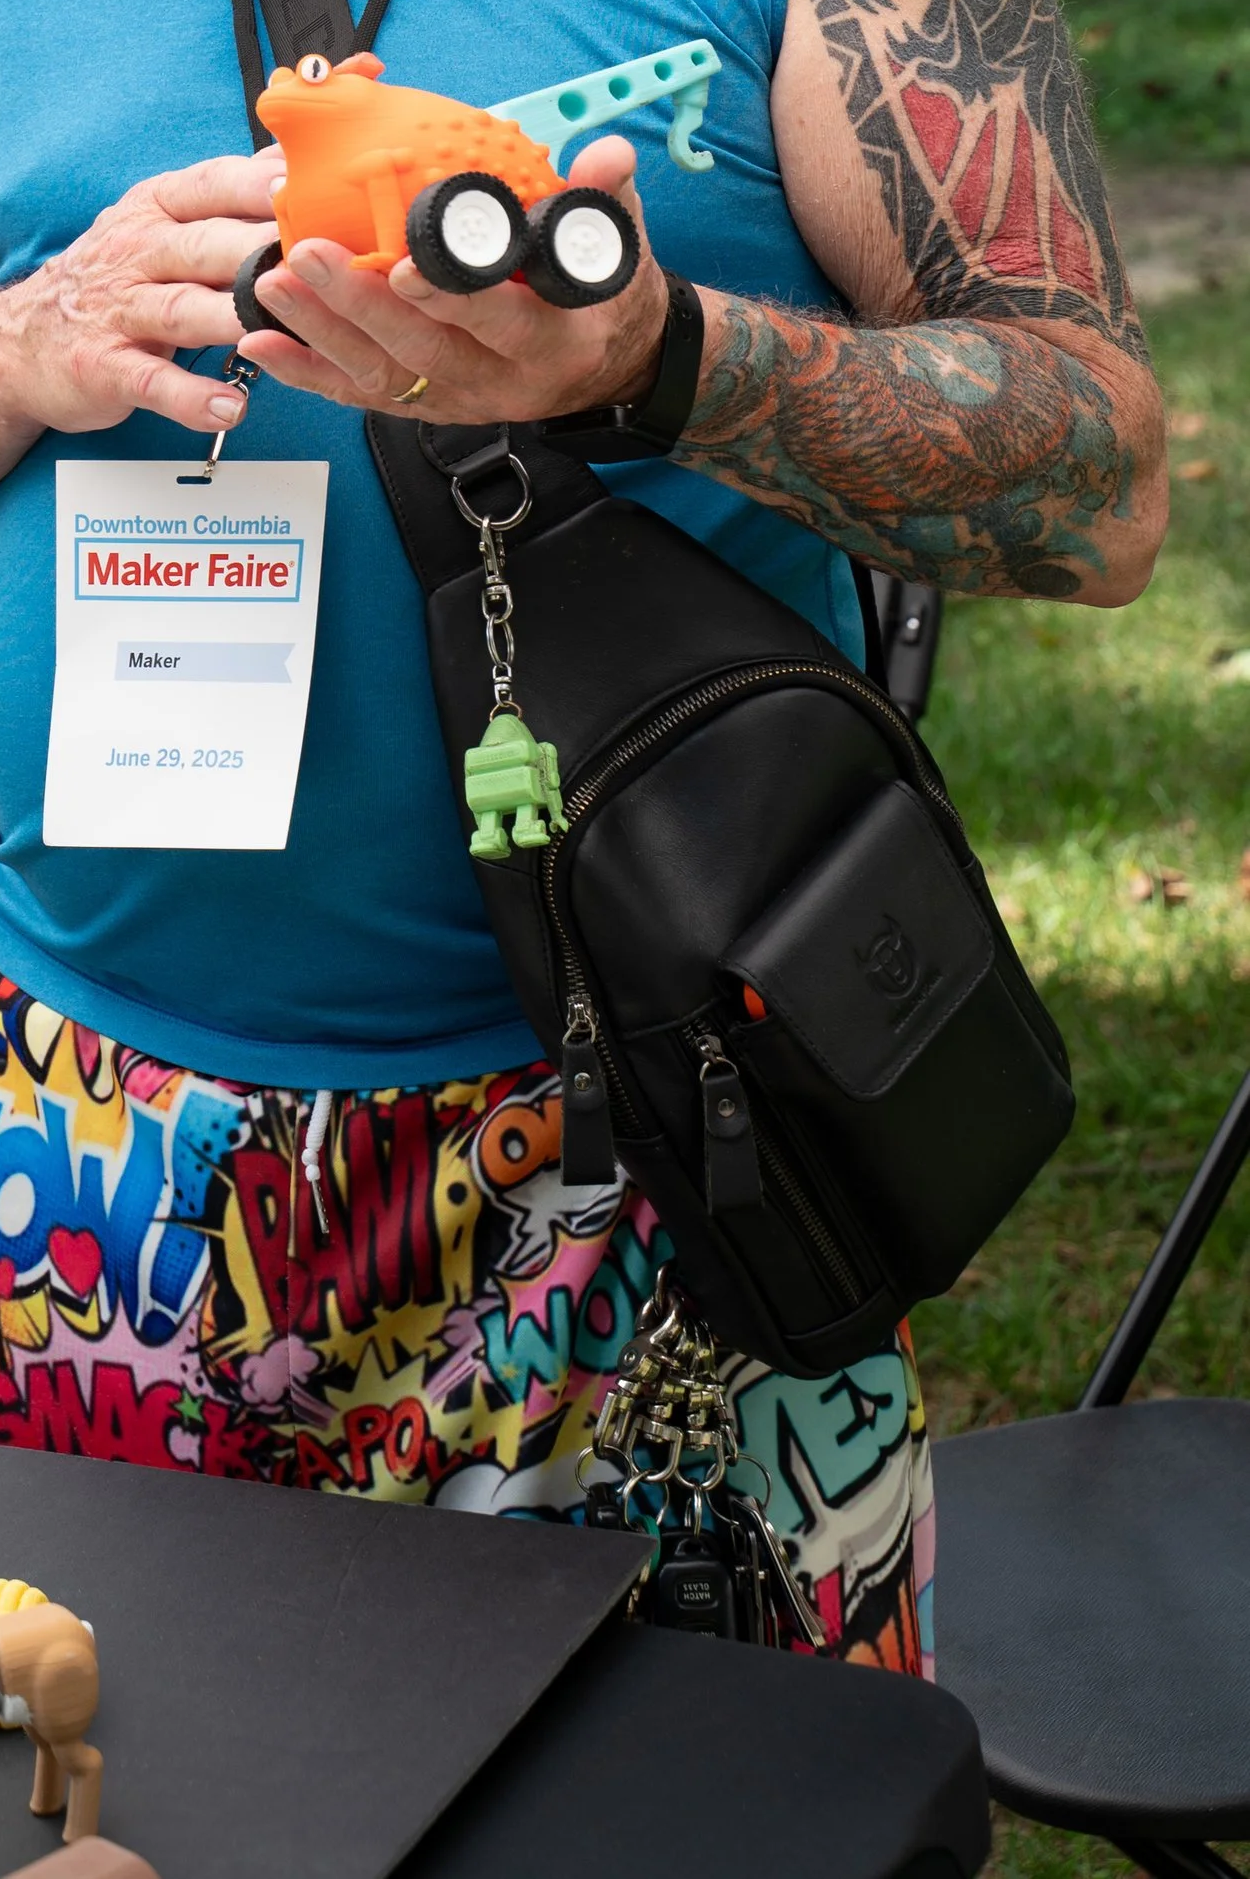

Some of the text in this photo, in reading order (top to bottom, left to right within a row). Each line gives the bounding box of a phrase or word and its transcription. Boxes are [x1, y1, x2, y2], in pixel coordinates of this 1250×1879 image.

[74, 513, 291, 536] Downtown Columbia
[87, 552, 289, 588] Maker Faire
[128, 652, 180, 670] Maker
[105, 748, 244, 770] June 29, 2025
